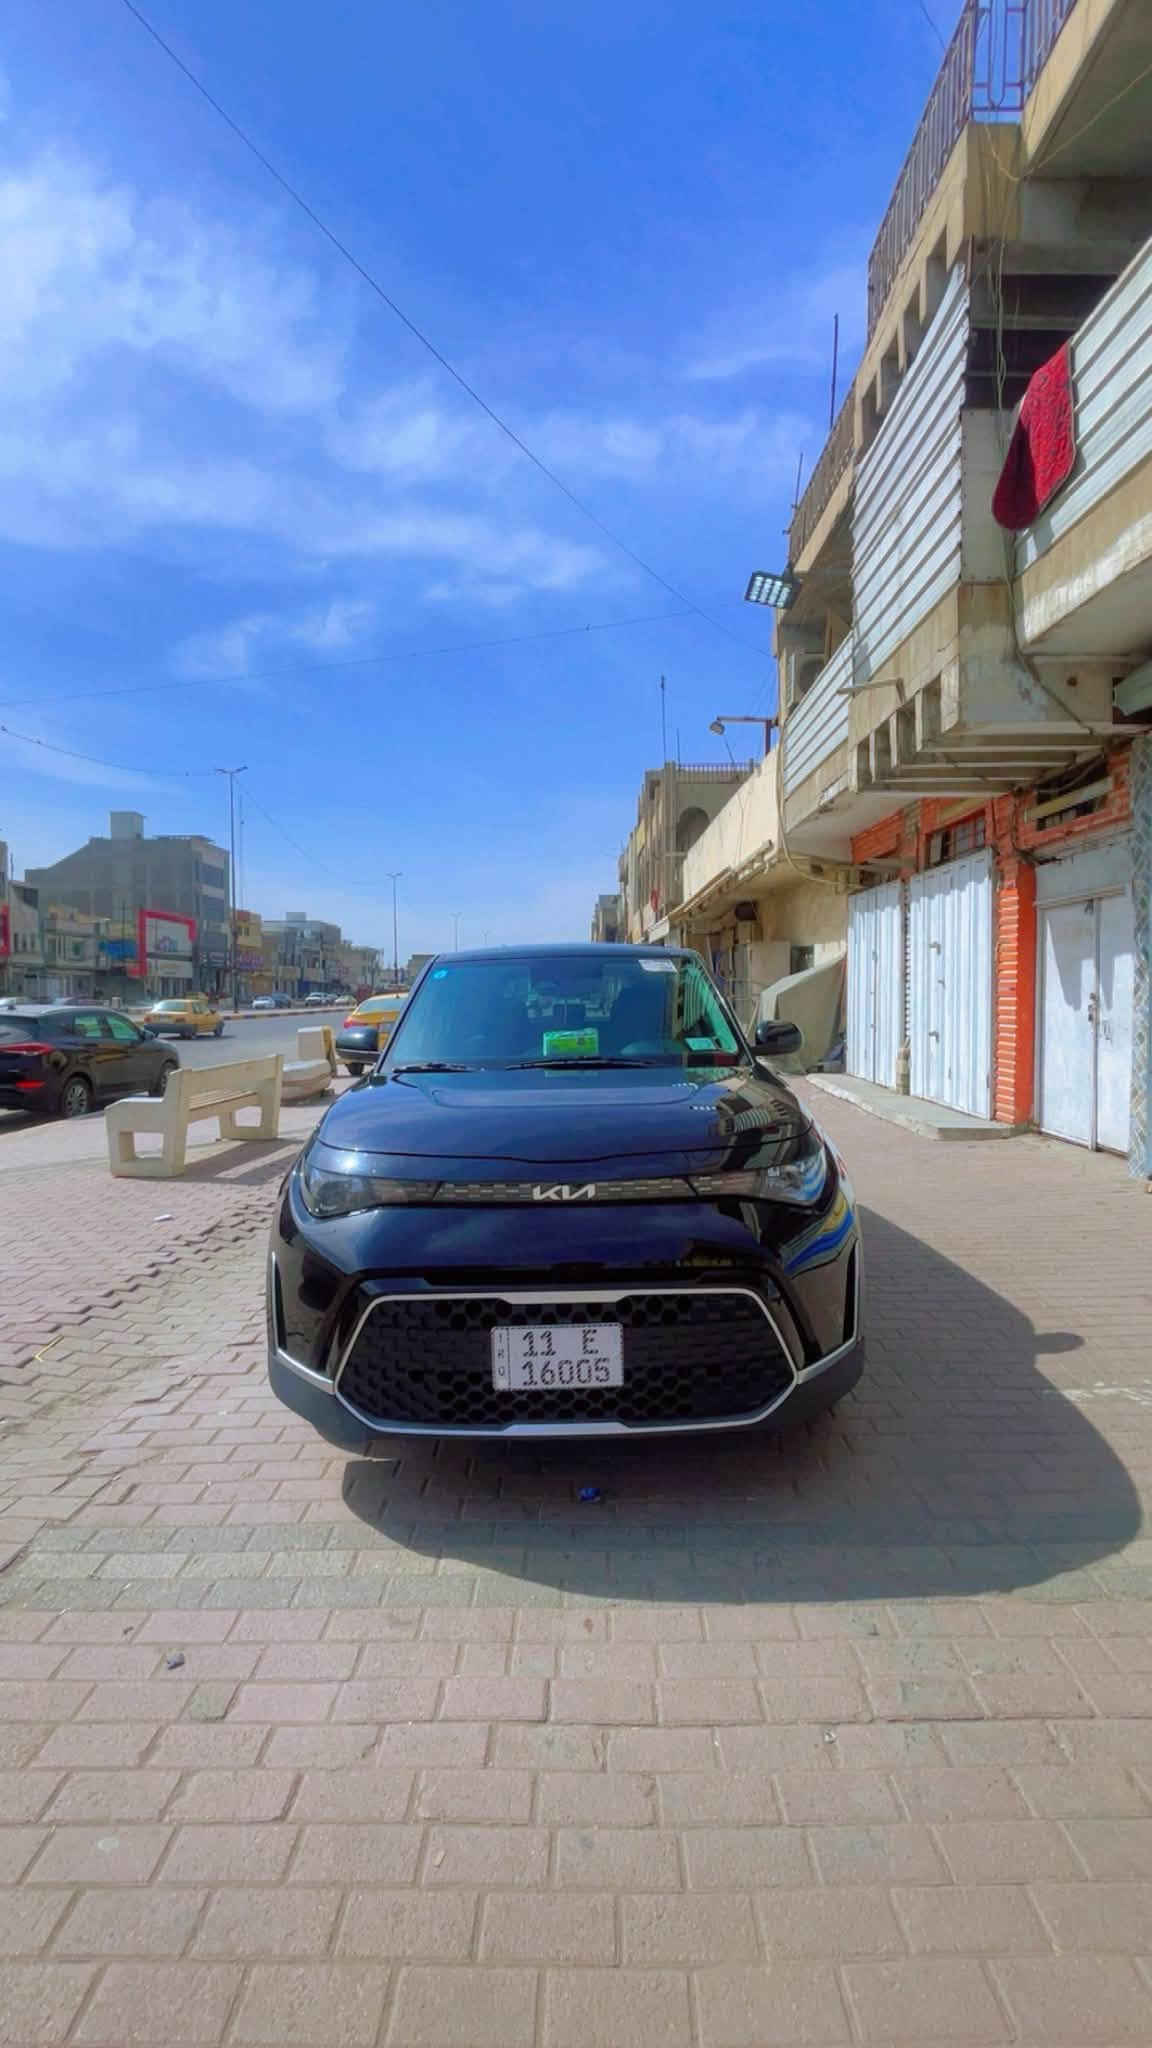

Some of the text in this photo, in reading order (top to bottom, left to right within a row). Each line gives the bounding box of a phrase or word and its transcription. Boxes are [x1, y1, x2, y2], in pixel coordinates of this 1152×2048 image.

[532, 1184, 596, 1201] KIA
[522, 1328, 599, 1357] 11 E
[521, 1357, 611, 1386] 16005
